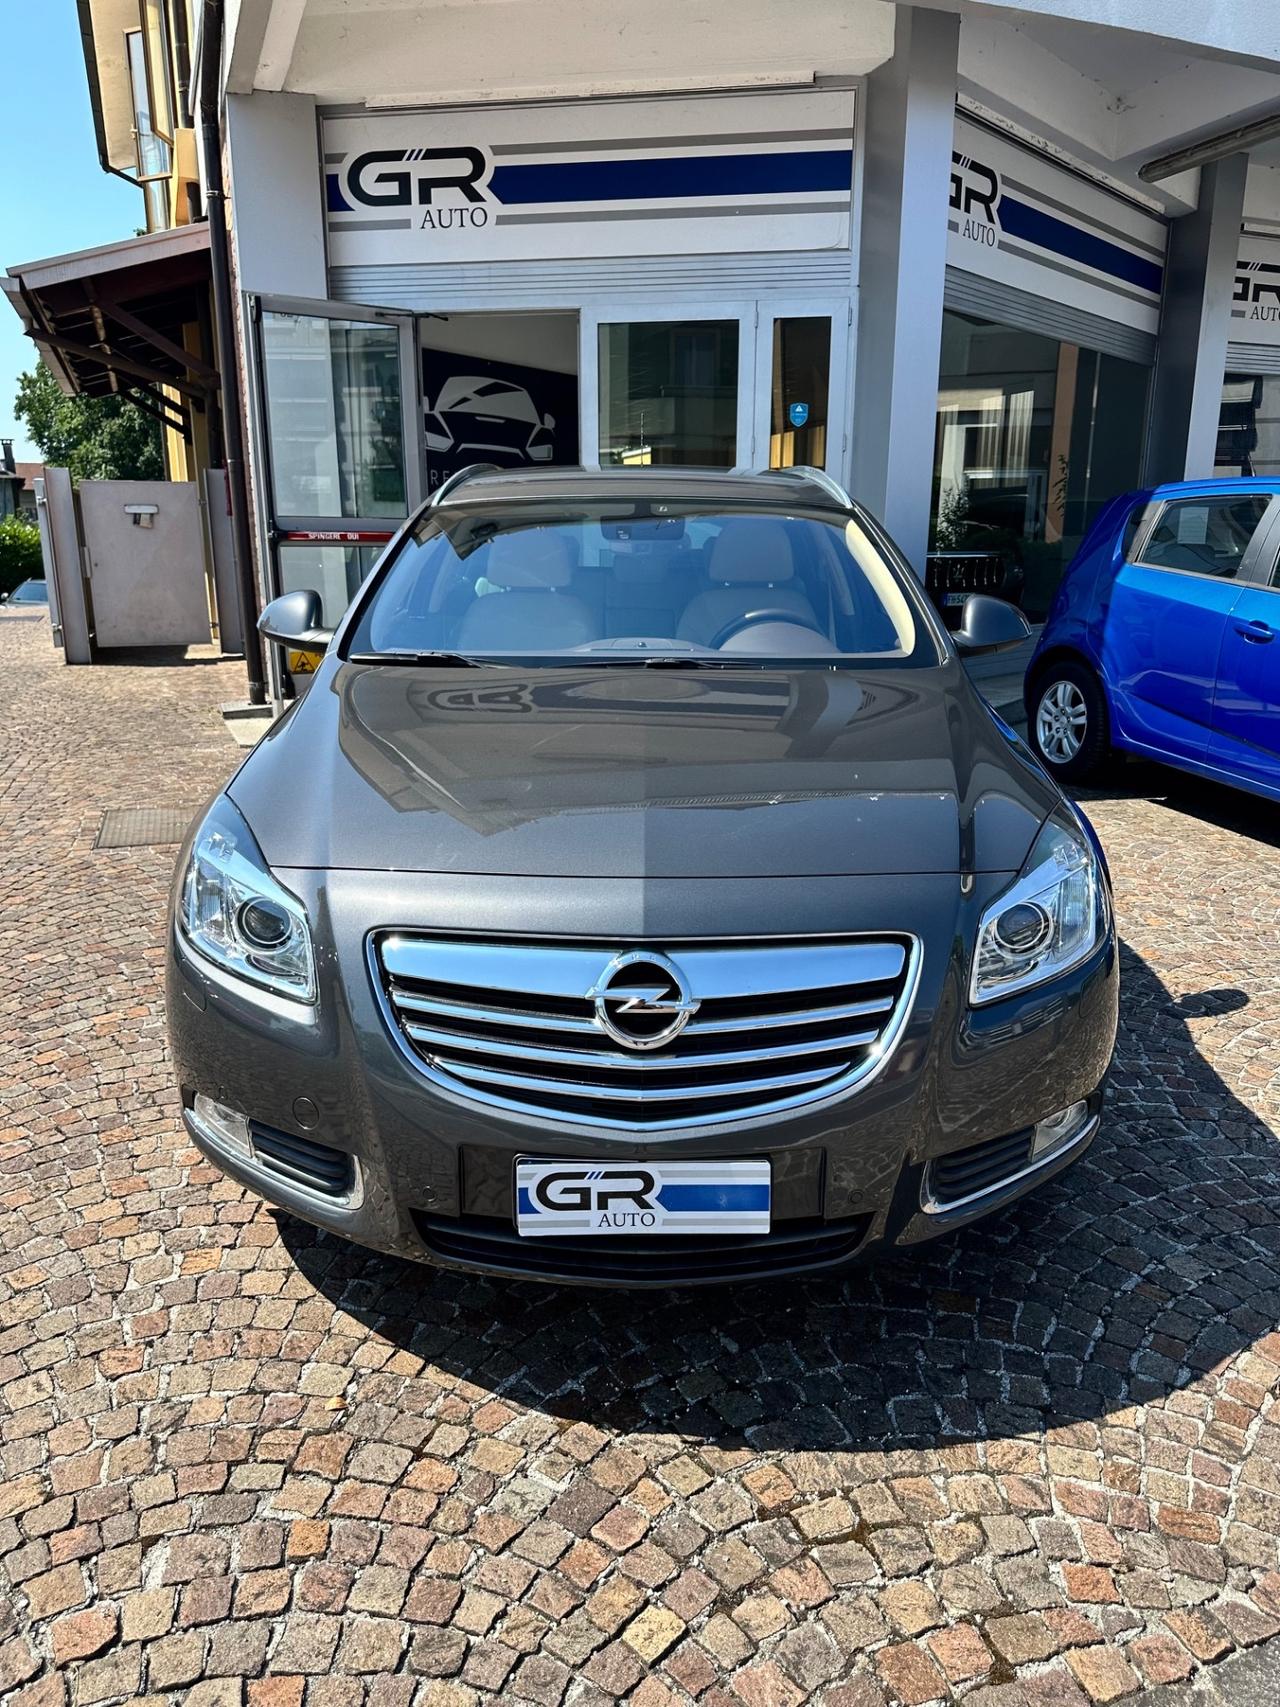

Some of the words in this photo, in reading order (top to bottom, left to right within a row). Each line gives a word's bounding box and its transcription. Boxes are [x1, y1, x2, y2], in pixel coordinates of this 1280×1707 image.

[347, 146, 488, 208] GR
[420, 207, 488, 230] AUTO
[963, 218, 995, 247] AUTO
[1250, 305, 1280, 322] AUT
[536, 1170, 656, 1212] GR
[598, 1212, 656, 1228] AUTO
